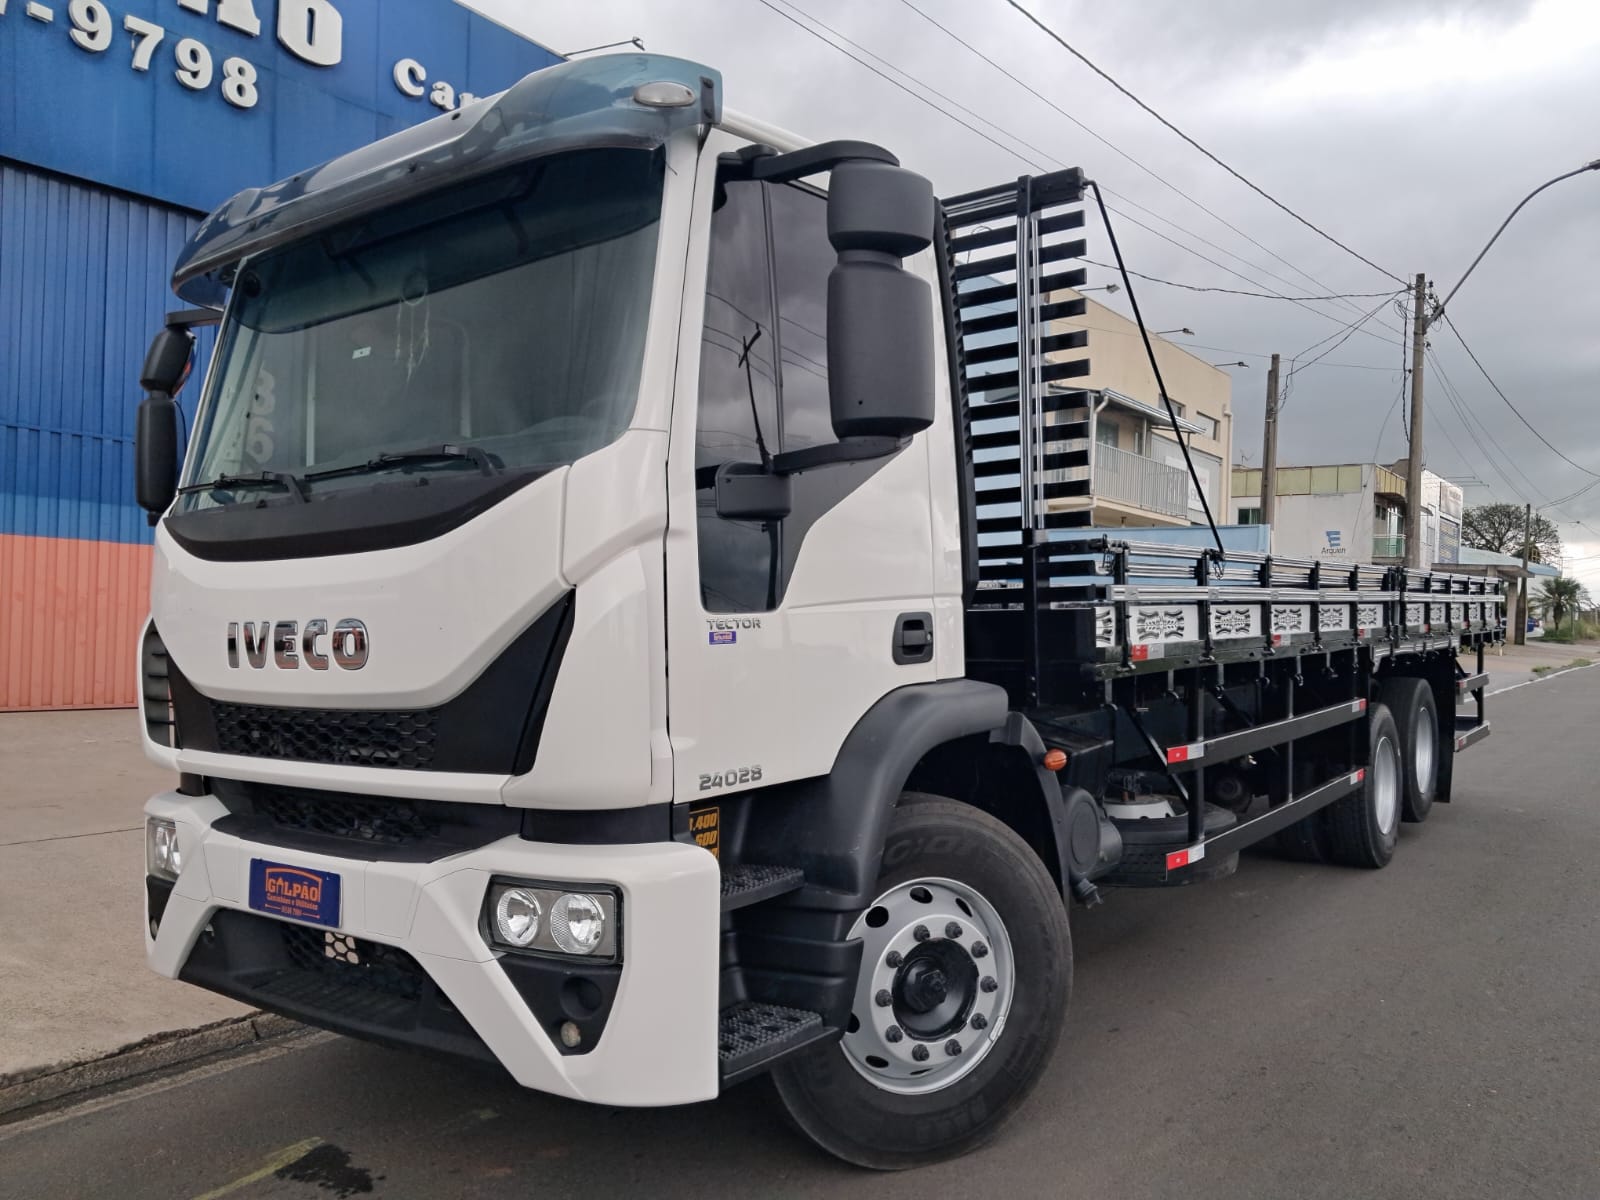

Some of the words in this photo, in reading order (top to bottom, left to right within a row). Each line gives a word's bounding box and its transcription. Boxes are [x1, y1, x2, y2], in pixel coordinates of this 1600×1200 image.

[0, 0, 258, 108] -9798
[227, 617, 370, 671] IVECO
[706, 618, 762, 630] TECTOR
[699, 764, 763, 791] 24028
